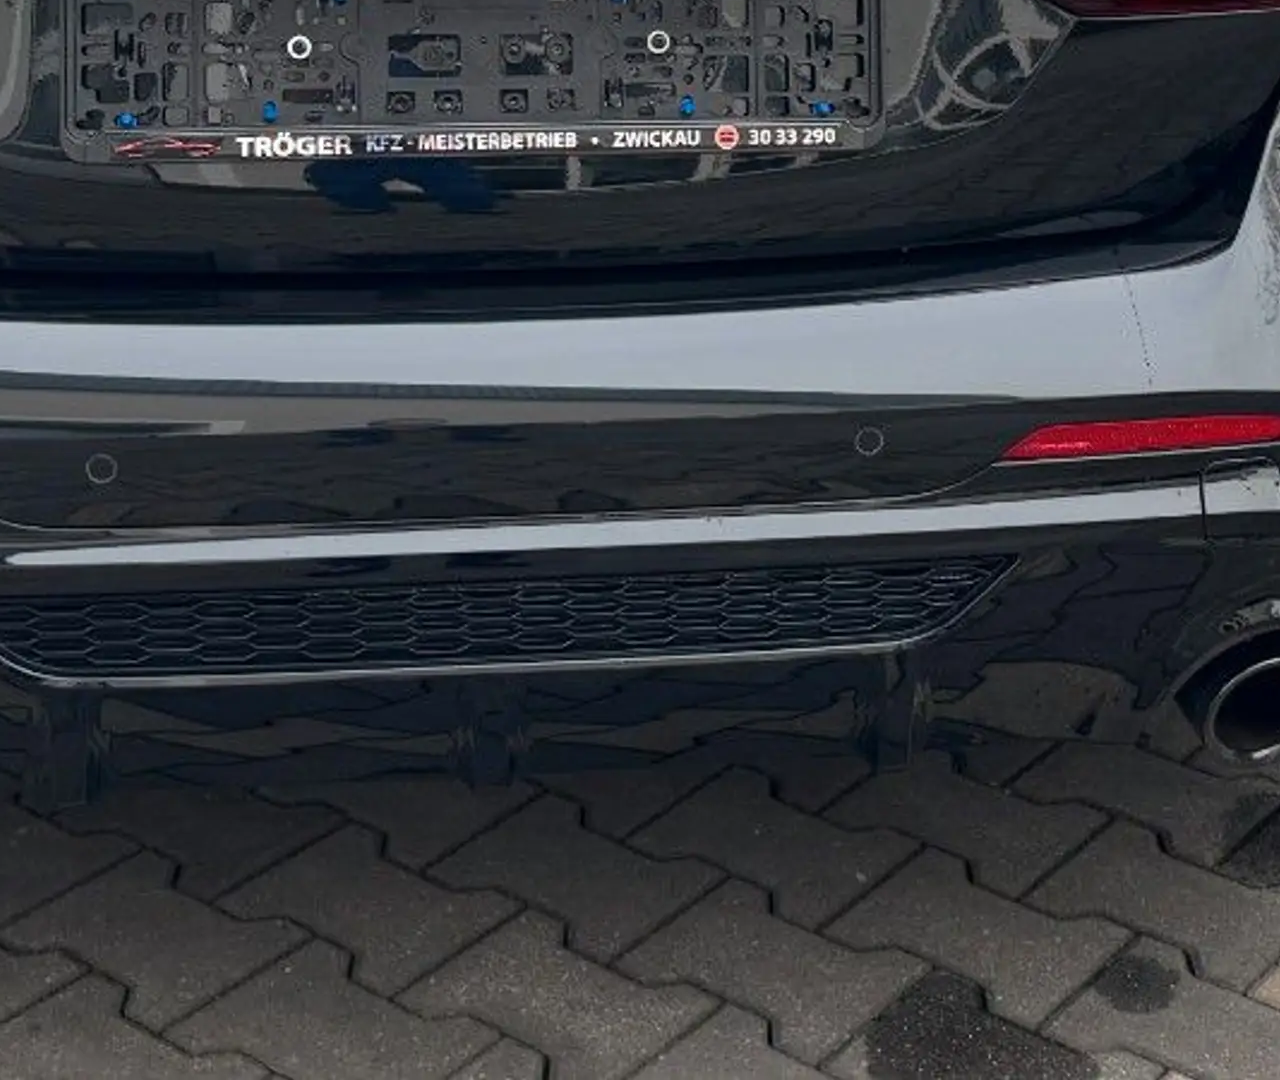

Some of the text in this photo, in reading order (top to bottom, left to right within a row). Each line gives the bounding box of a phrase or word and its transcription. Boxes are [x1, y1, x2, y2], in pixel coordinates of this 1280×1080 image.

[236, 132, 353, 157] TRÖGER
[365, 133, 404, 152] KFZ
[612, 130, 701, 148] ZWICKAU
[748, 128, 770, 146] 30
[775, 128, 798, 145] 33
[802, 127, 836, 145] 290
